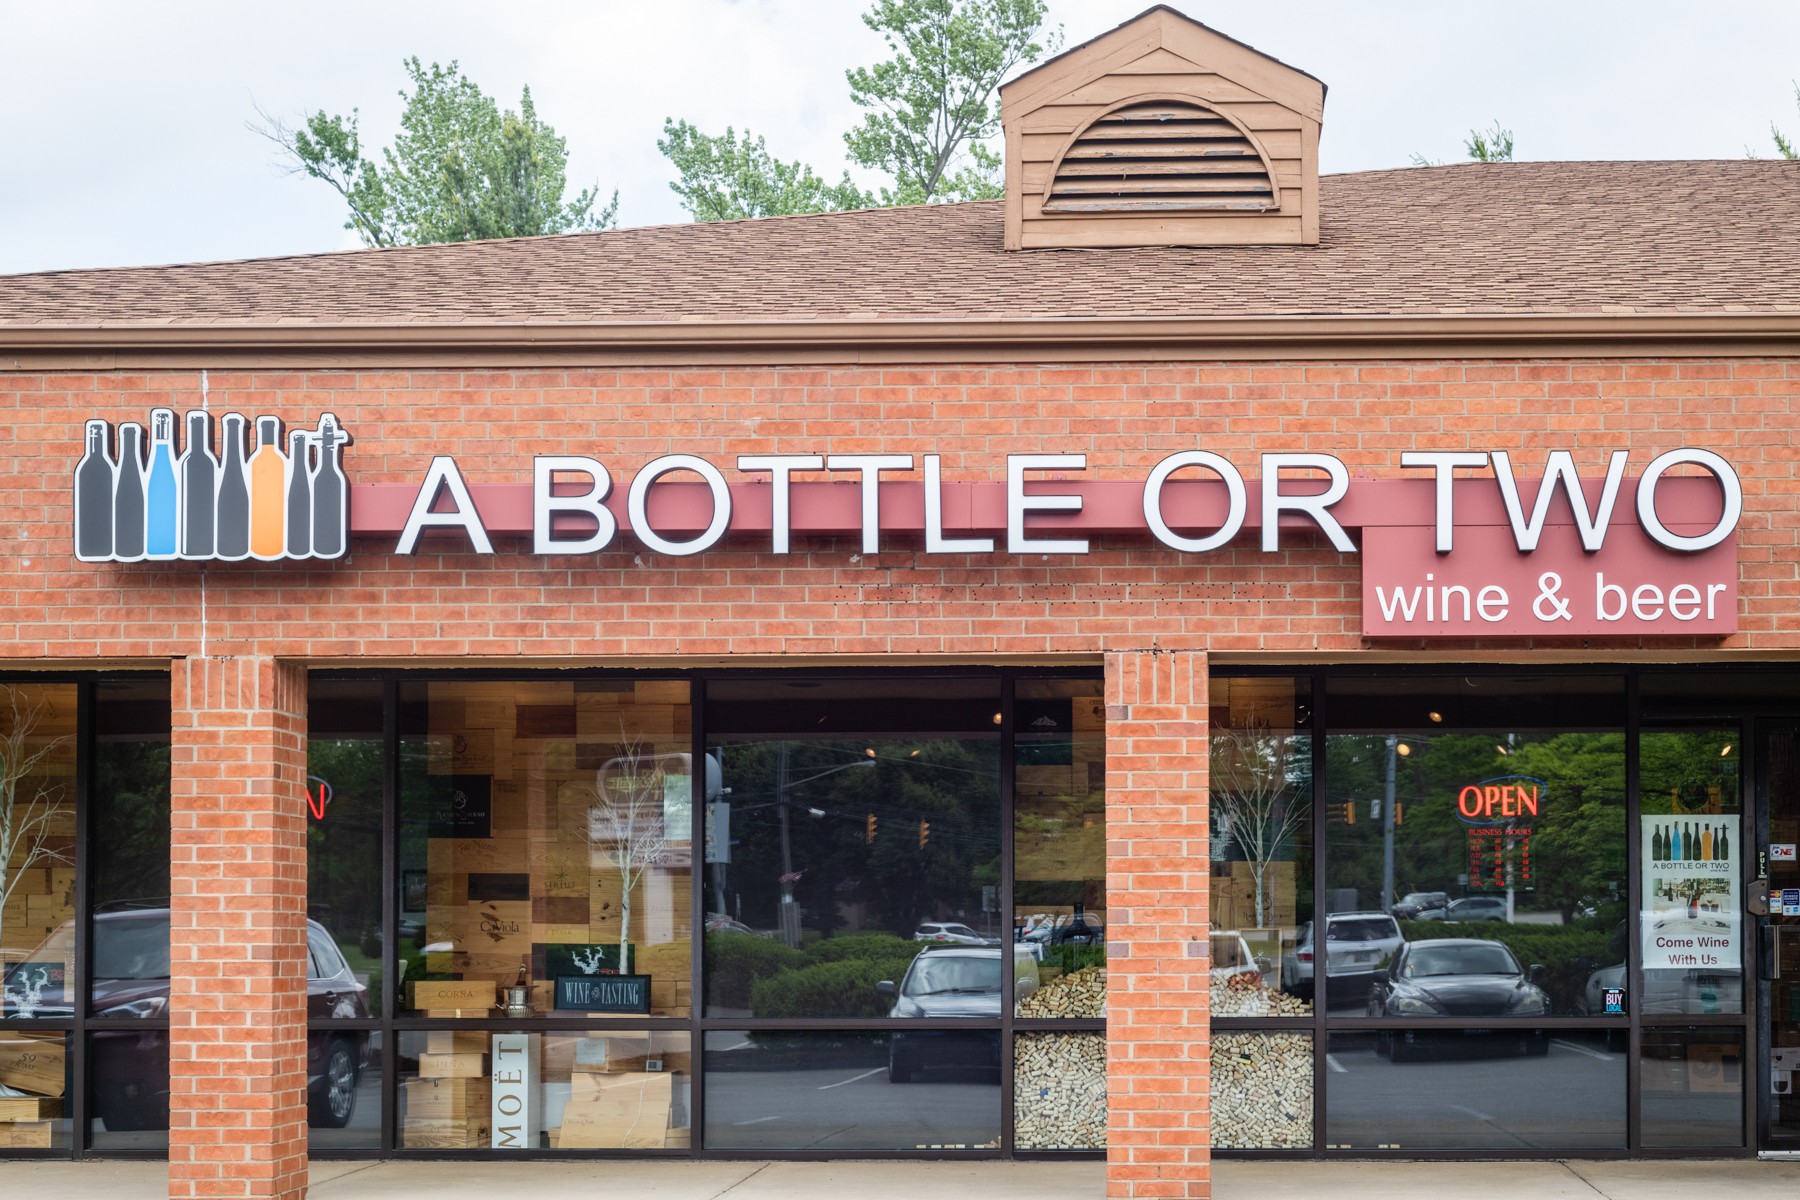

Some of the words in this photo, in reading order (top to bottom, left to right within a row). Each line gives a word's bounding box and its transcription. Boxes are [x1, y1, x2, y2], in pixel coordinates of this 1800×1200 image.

[394, 455, 497, 556] A
[533, 453, 1090, 556] BOTTLE
[1142, 450, 1357, 553] OR
[1401, 447, 1743, 556] TWO
[1375, 573, 1510, 622] wine
[1532, 571, 1573, 621] &
[1596, 571, 1727, 621] beer
[1458, 785, 1538, 817] OPEN
[1469, 828, 1503, 836] BUSINESS
[1505, 828, 1533, 836] HOURS
[1656, 937, 1693, 948] Come
[1697, 937, 1730, 948] Wine
[1668, 954, 1697, 965] With
[1701, 954, 1718, 965] Us
[565, 982, 591, 1004] WINE
[600, 982, 639, 1005] TASTING
[1606, 994, 1623, 1005] BUY
[494, 1041, 522, 1148] MOËT
